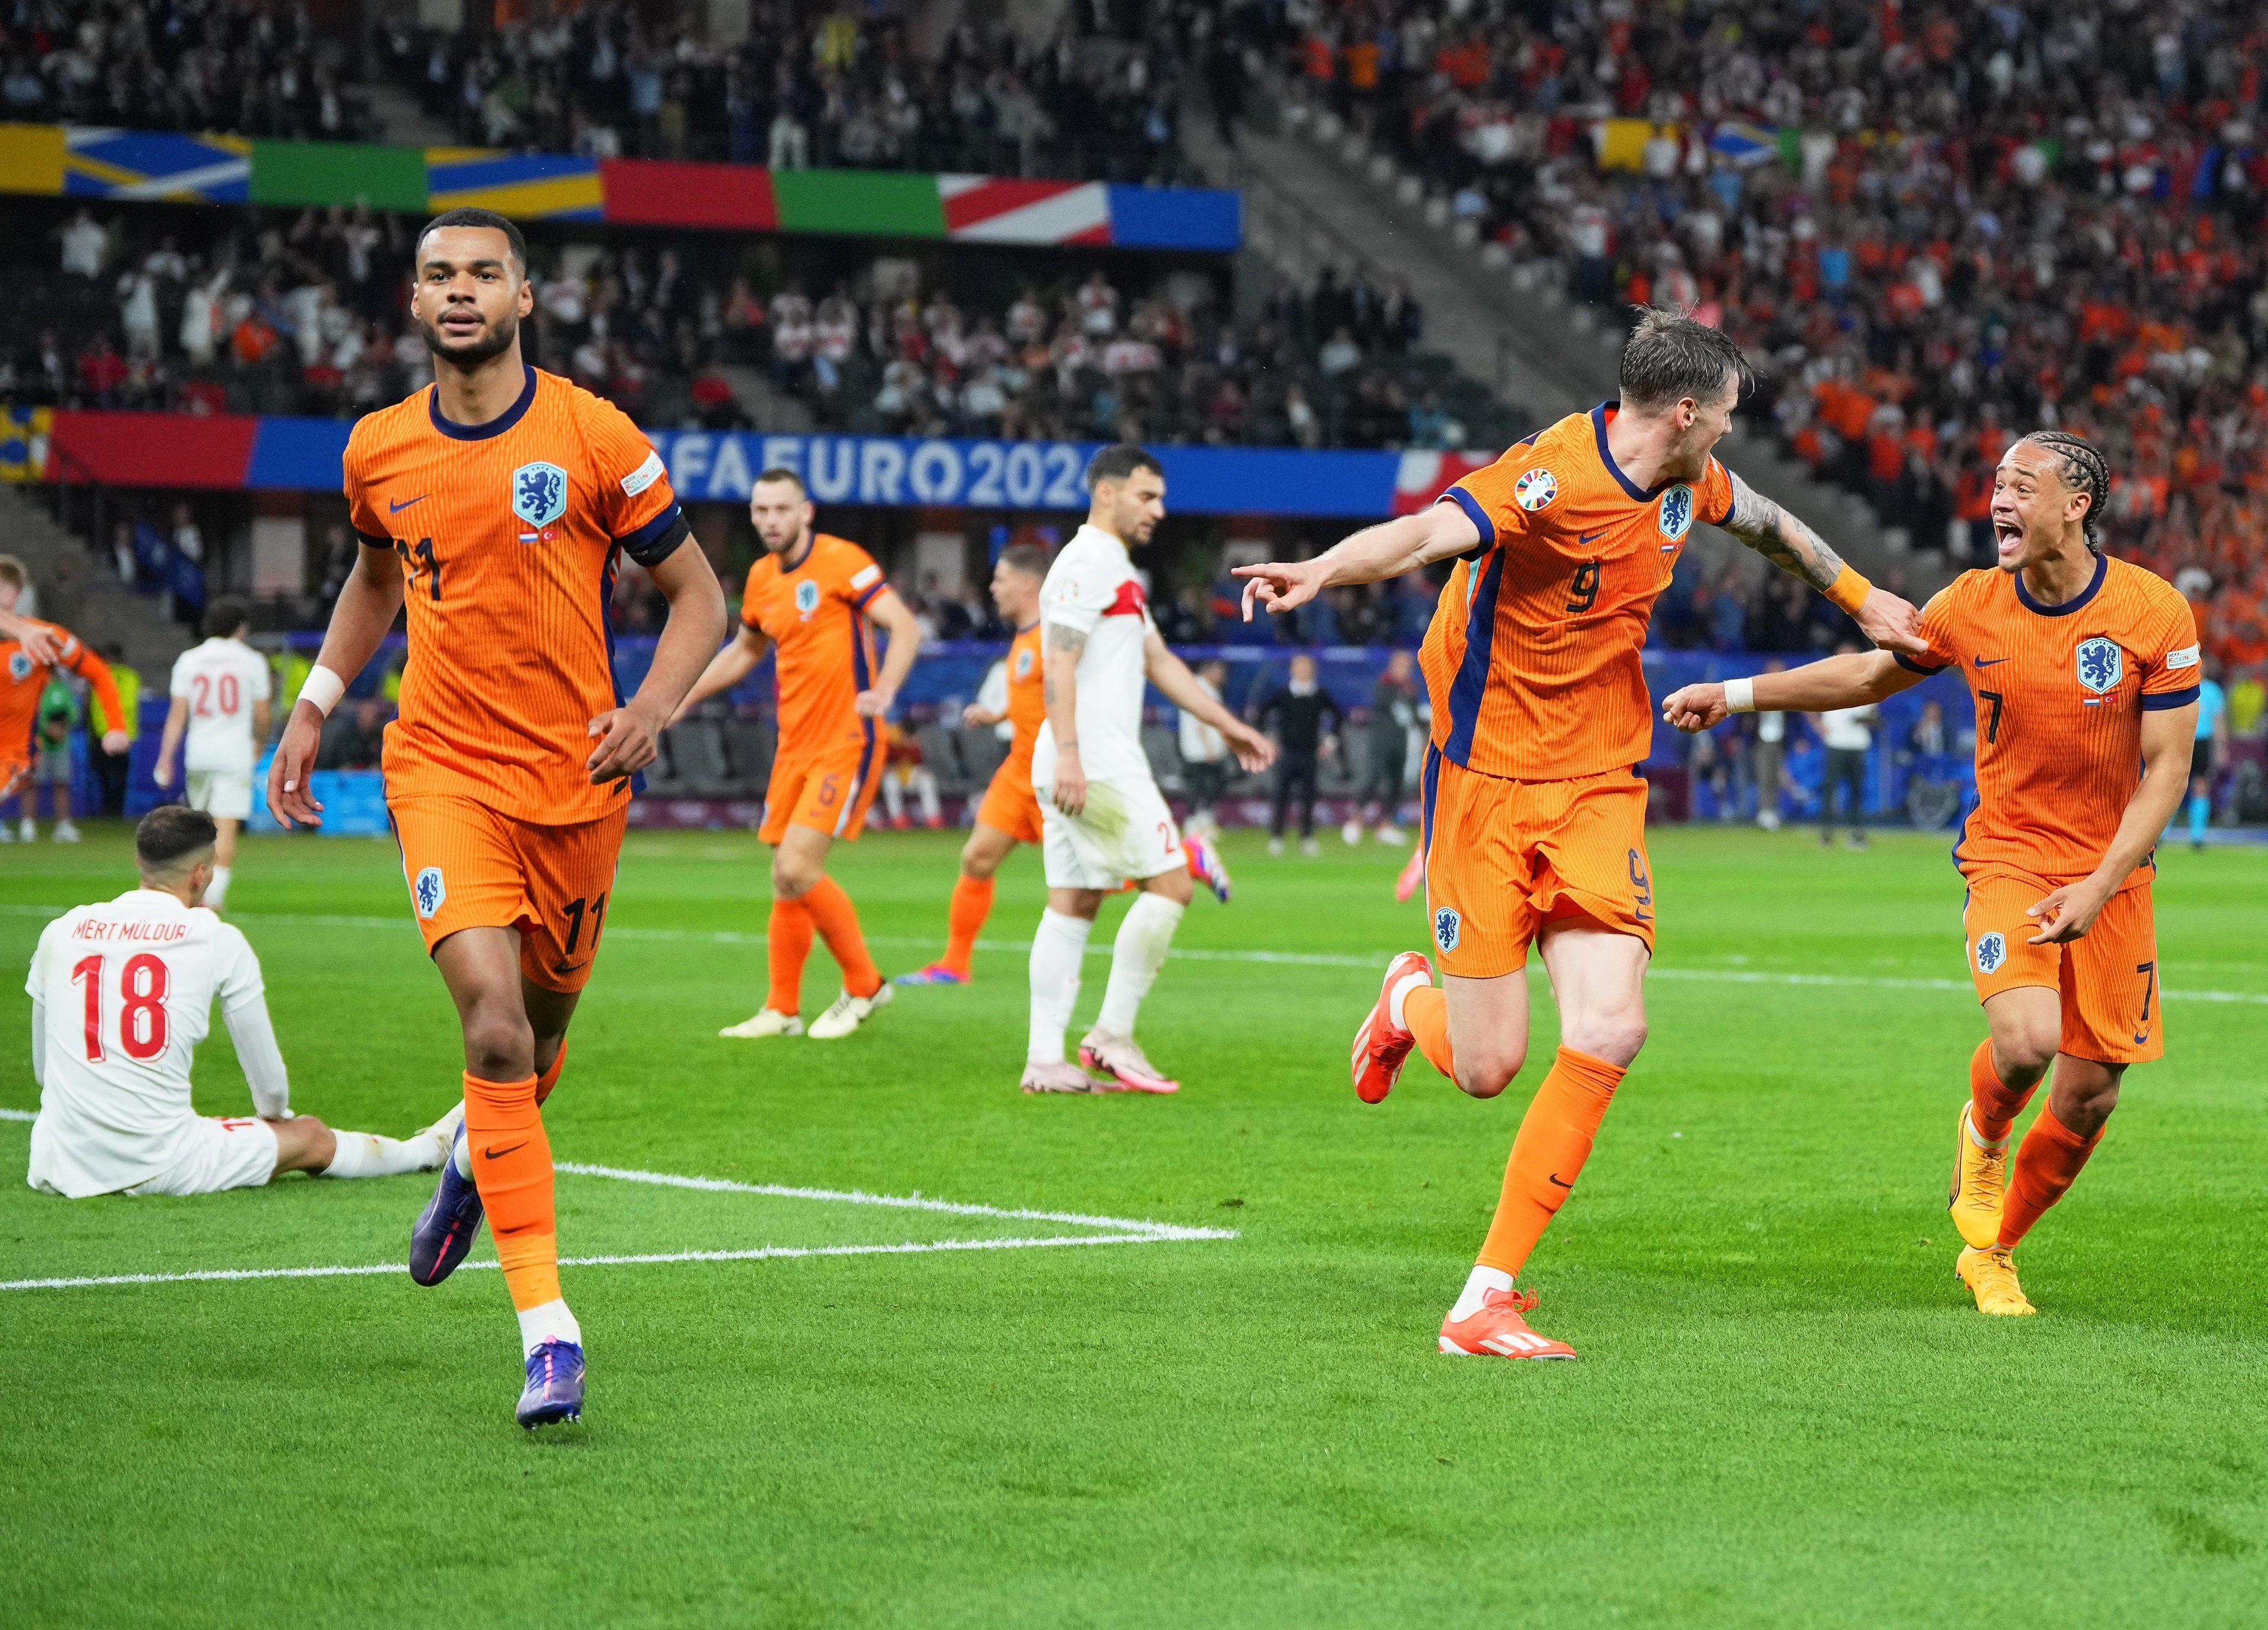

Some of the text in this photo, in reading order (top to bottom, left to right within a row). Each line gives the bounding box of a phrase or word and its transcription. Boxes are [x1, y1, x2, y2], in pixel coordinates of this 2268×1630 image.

[1566, 561, 1600, 612] 9
[192, 672, 240, 717] 20
[1979, 689, 2002, 745] 7
[819, 772, 839, 806] 6
[1628, 847, 1651, 907] 9
[71, 918, 118, 940] MERT
[562, 891, 605, 955] 11
[71, 953, 170, 1064] 18
[2136, 960, 2153, 1022] 7
